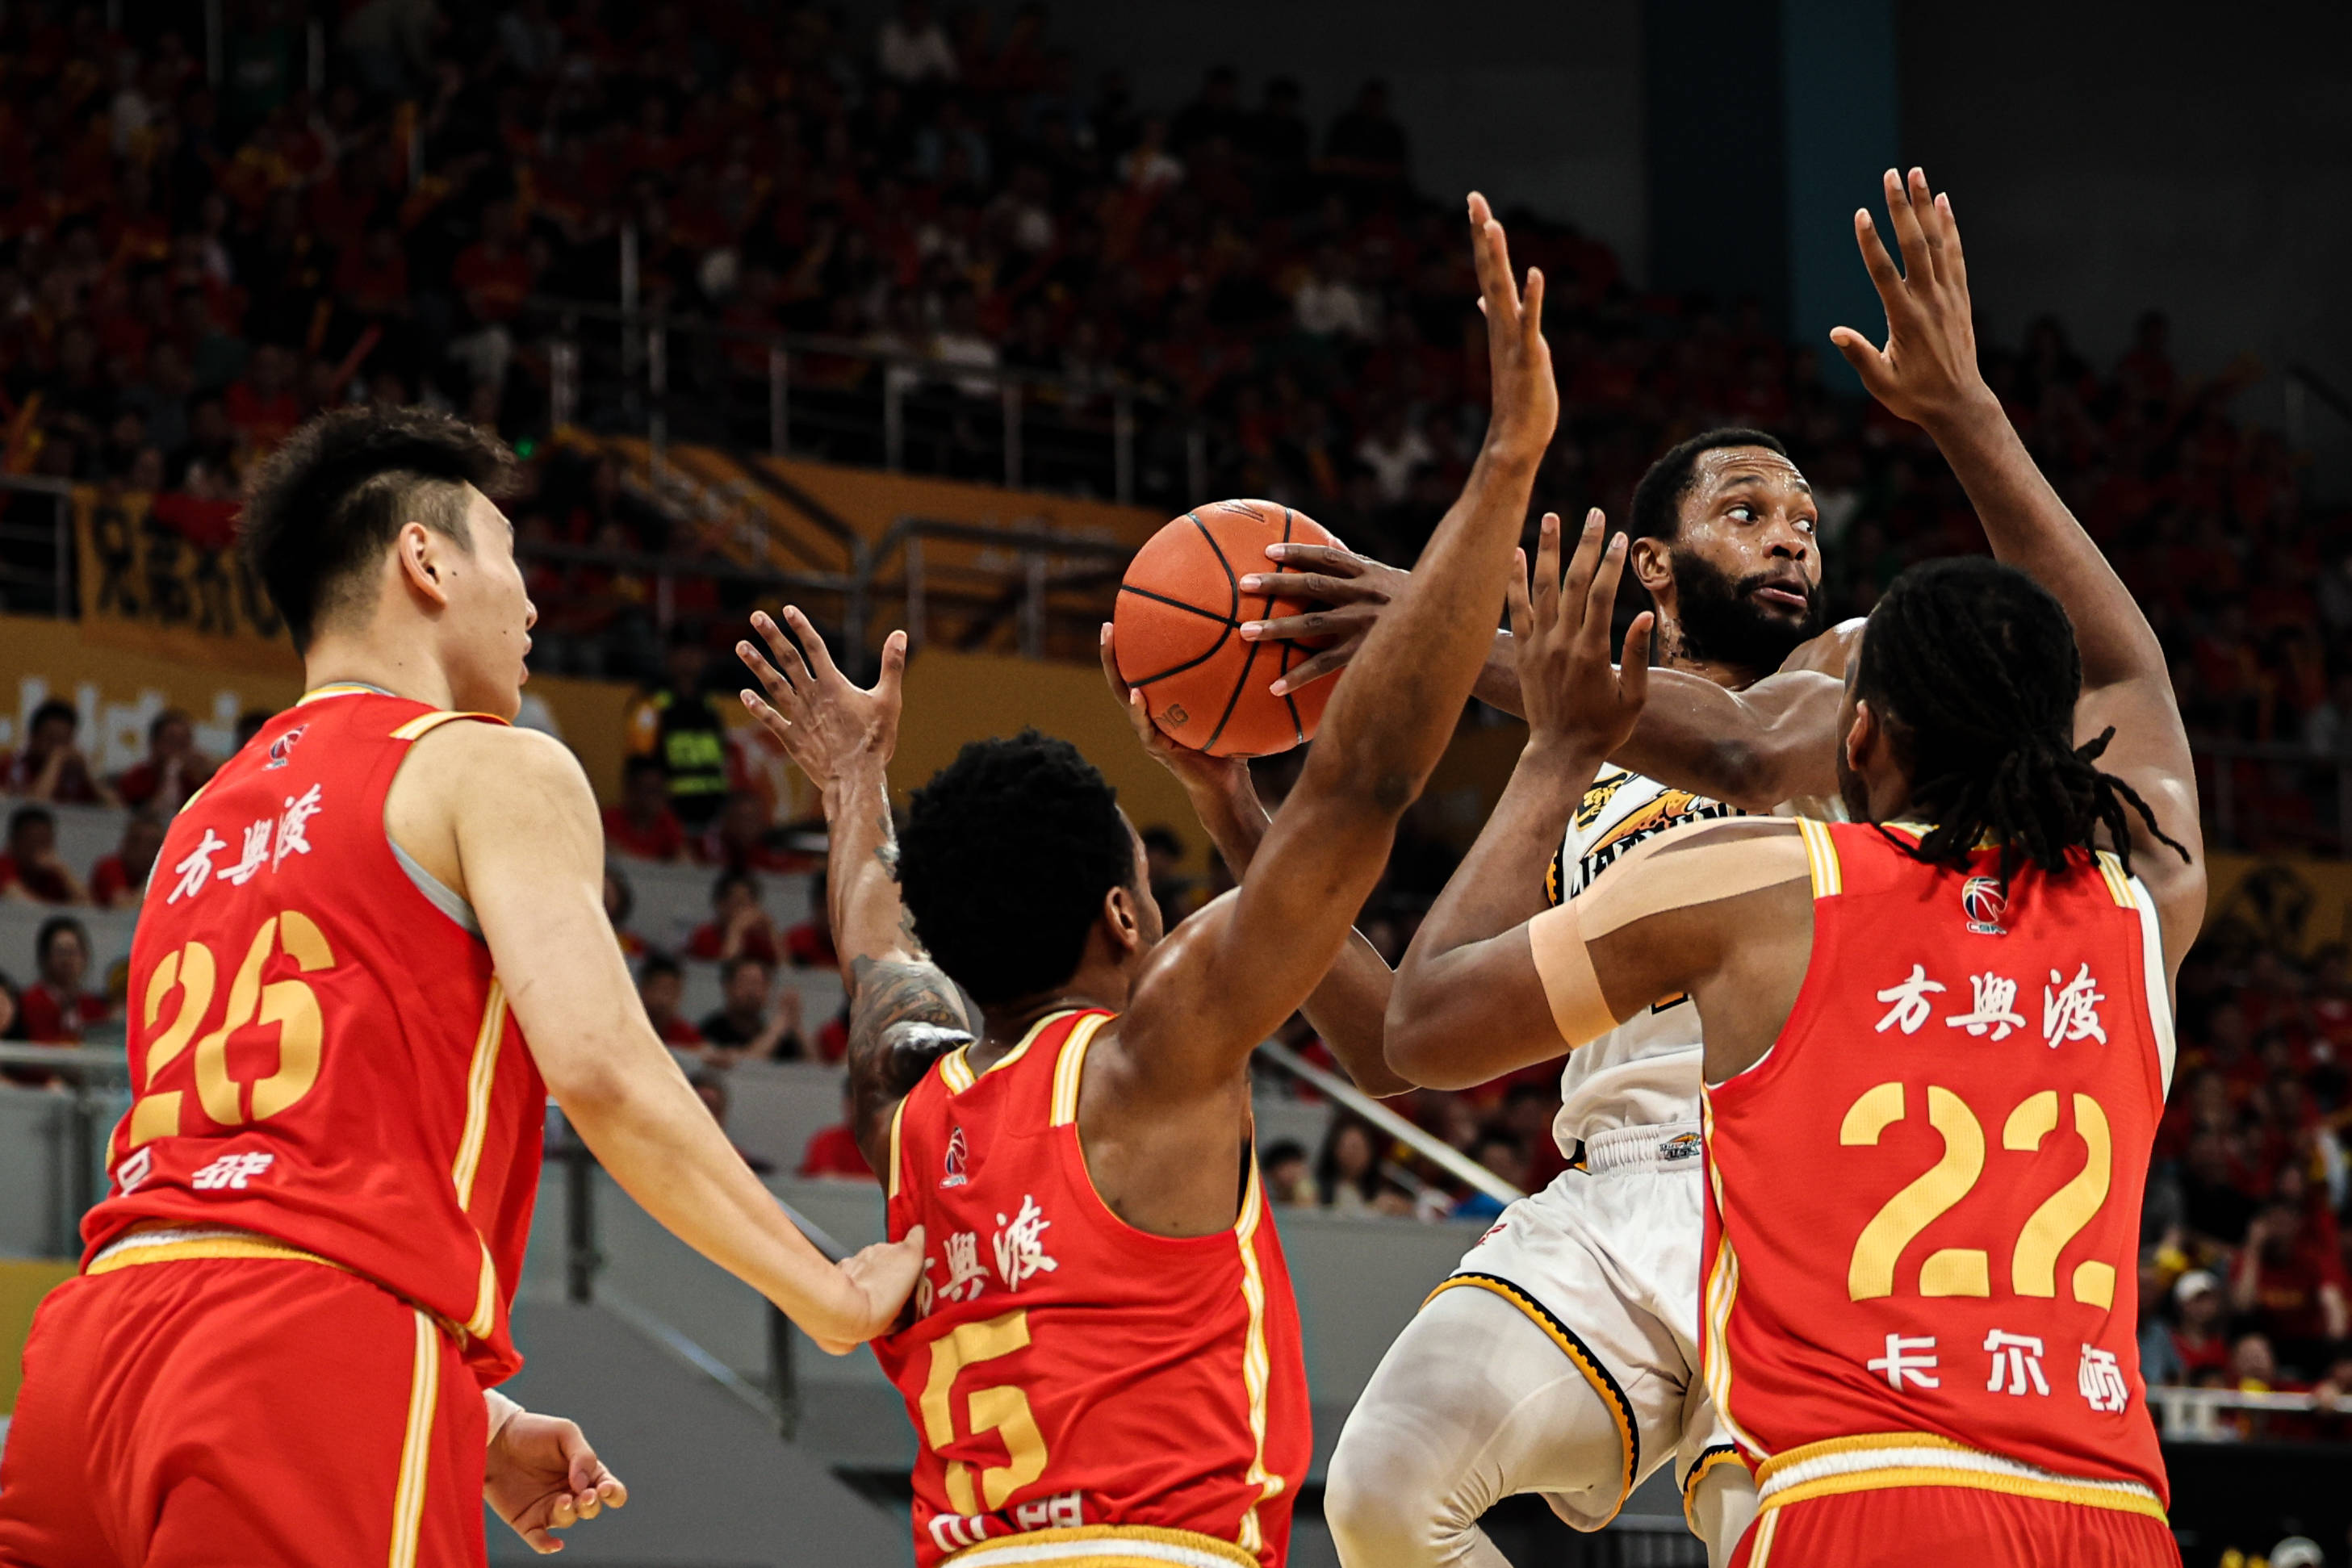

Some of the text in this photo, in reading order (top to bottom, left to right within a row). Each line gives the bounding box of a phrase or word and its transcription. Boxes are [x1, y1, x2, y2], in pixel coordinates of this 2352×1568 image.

[129, 909, 336, 1148] 26
[1839, 1081, 2116, 1313] 22
[919, 1310, 1048, 1518] 5
[1867, 1329, 2128, 1414] 卡尔顿
